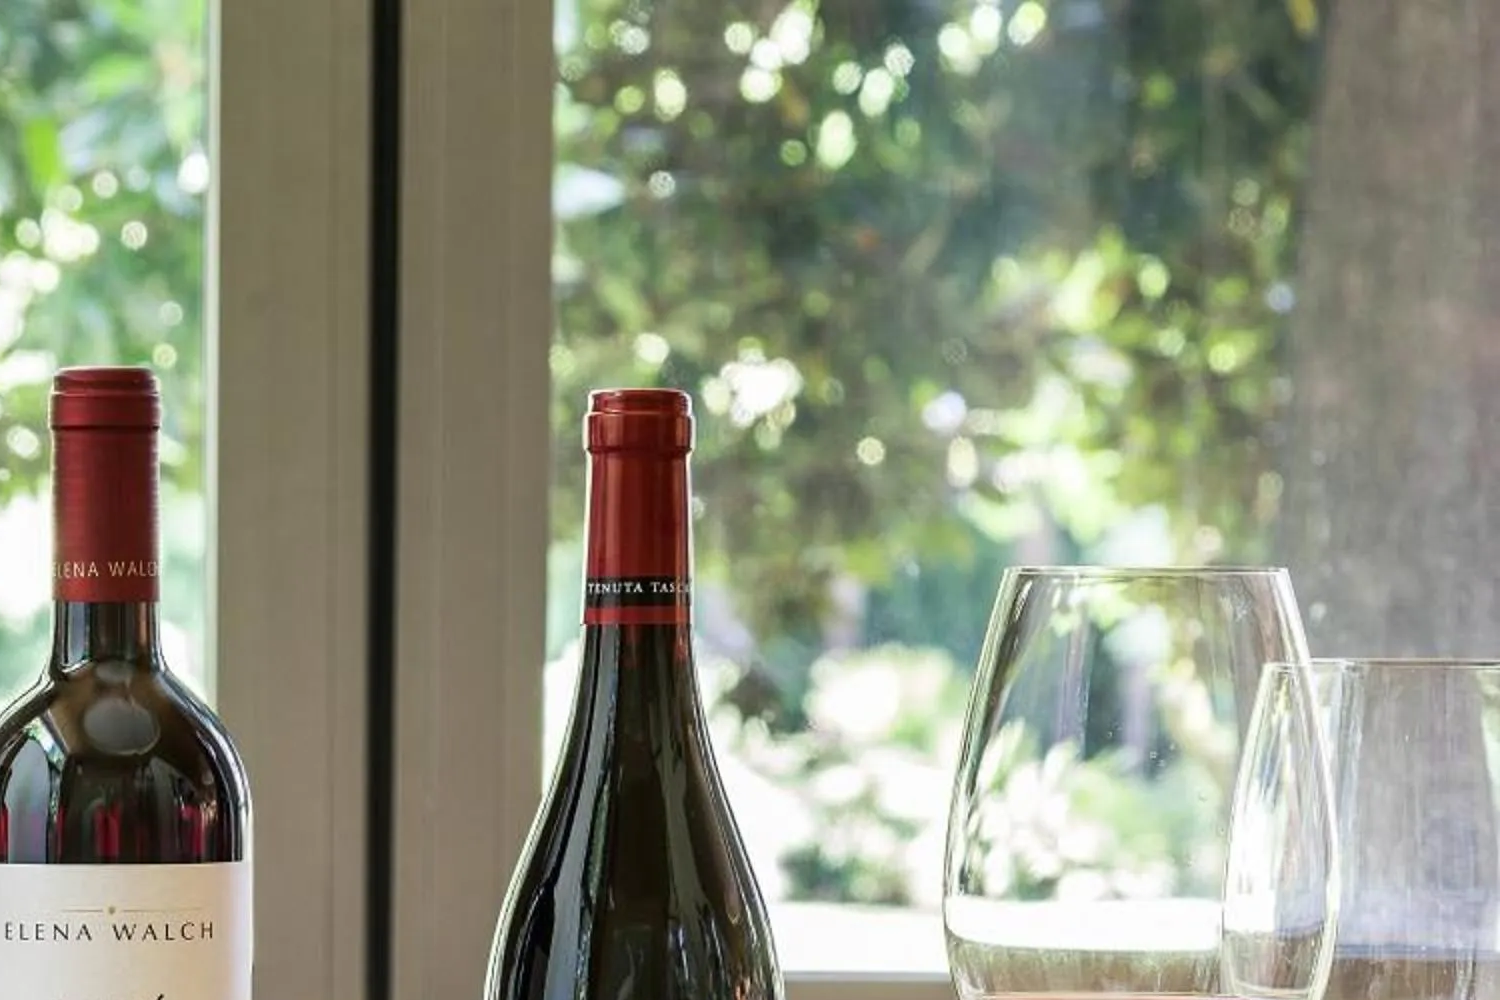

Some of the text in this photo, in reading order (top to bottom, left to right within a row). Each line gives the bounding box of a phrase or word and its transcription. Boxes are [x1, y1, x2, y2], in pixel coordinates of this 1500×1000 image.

[587, 582, 643, 594] TENUTA
[4, 921, 216, 941] ELENA WALCH
